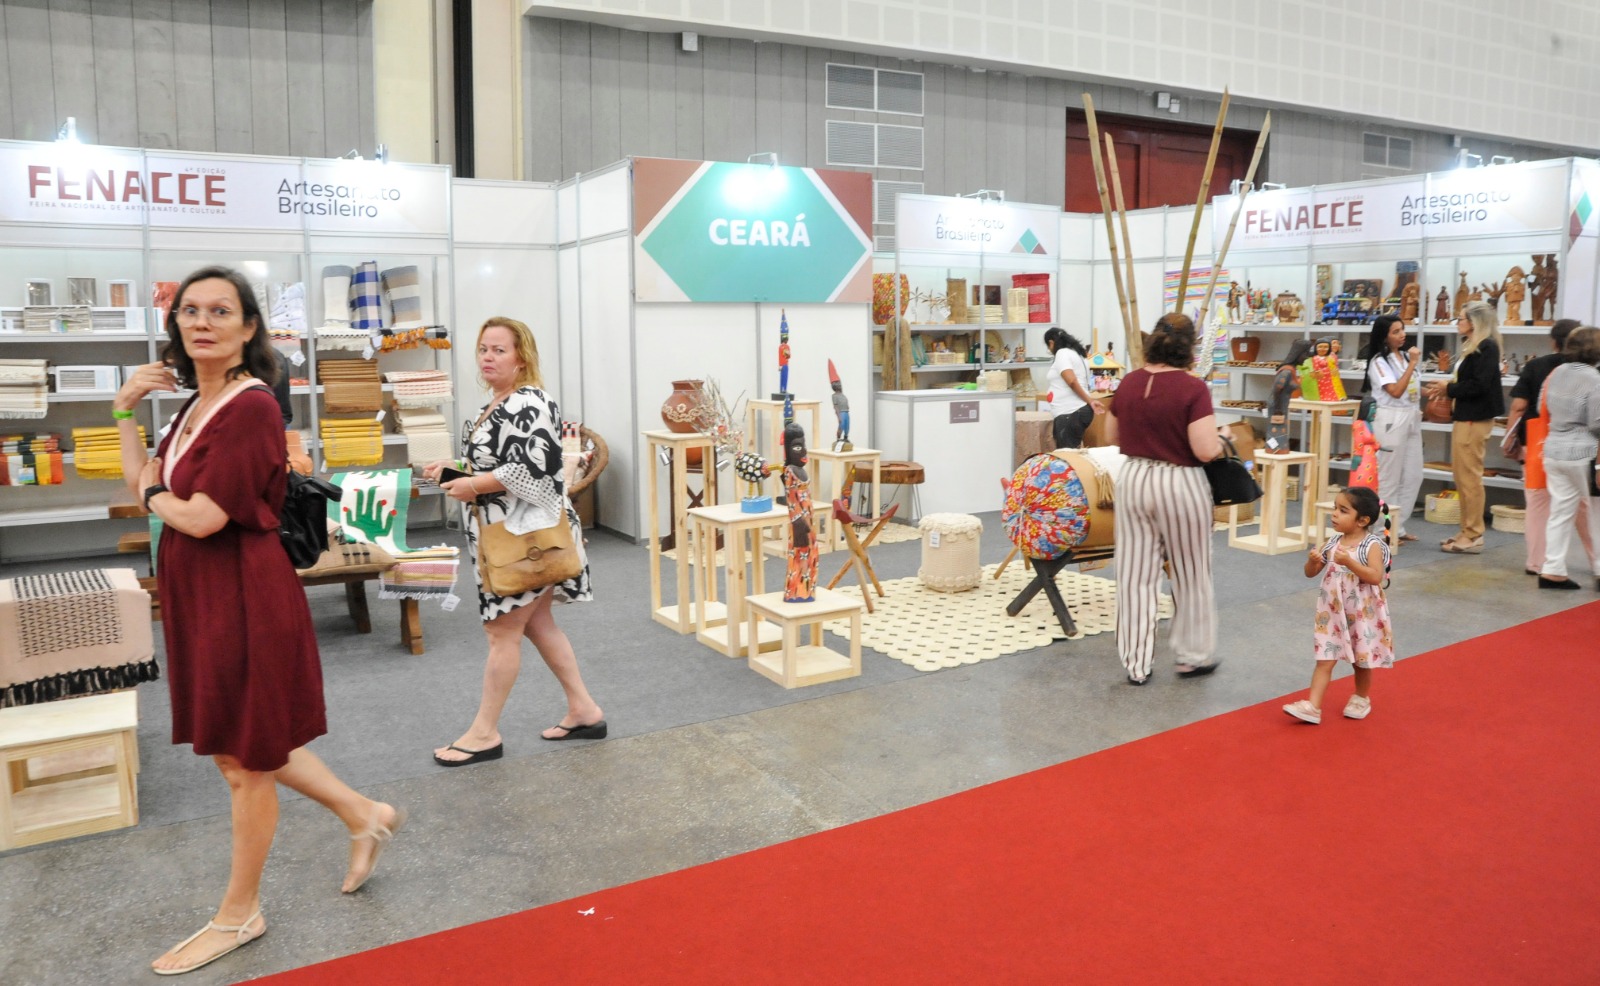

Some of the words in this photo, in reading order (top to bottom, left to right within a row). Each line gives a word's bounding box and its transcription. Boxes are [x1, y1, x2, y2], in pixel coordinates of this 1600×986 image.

[28, 165, 226, 207] FENACCE
[278, 197, 378, 218] Brasileiro
[1245, 200, 1364, 234] FENACCE
[1401, 206, 1488, 226] Brasileiro
[708, 212, 811, 247] CEARÁ
